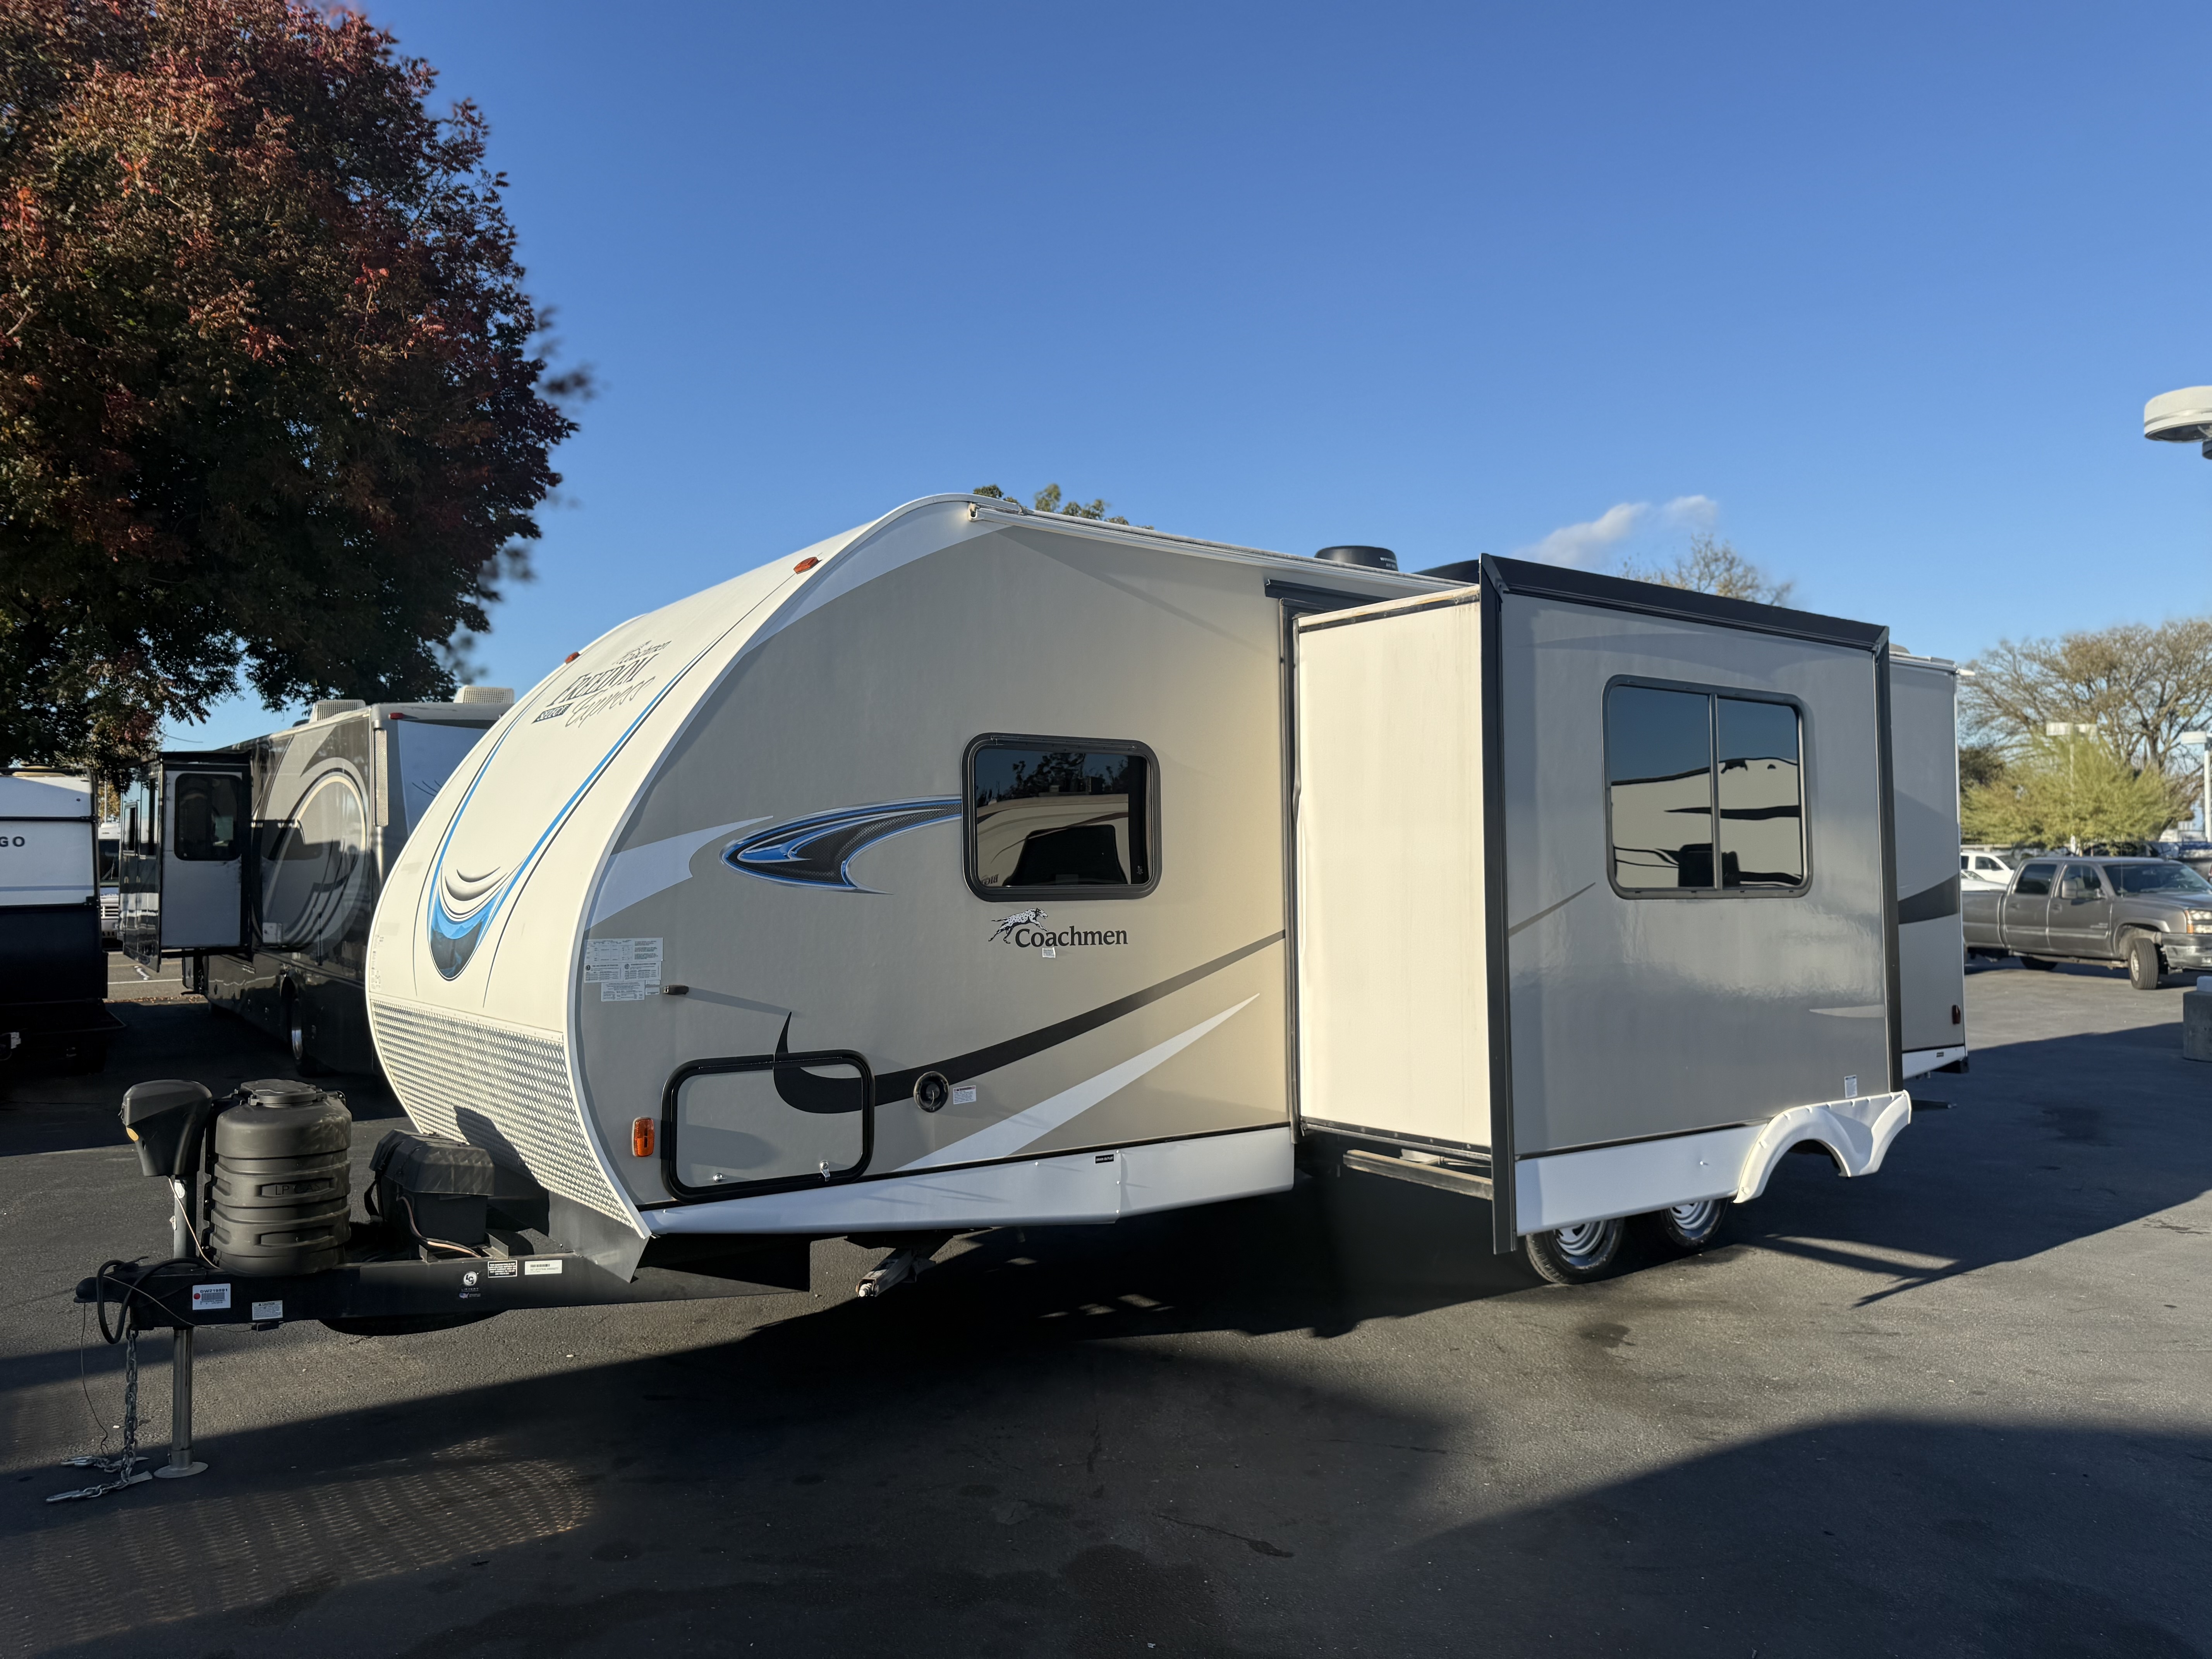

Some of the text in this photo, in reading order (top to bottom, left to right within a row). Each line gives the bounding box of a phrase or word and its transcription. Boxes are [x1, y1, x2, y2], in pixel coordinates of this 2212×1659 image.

[546, 653, 659, 708] FREEDOM
[565, 676, 656, 728] Express
[1015, 925, 1128, 948] Coachmen
[275, 1185, 289, 1195] LP
